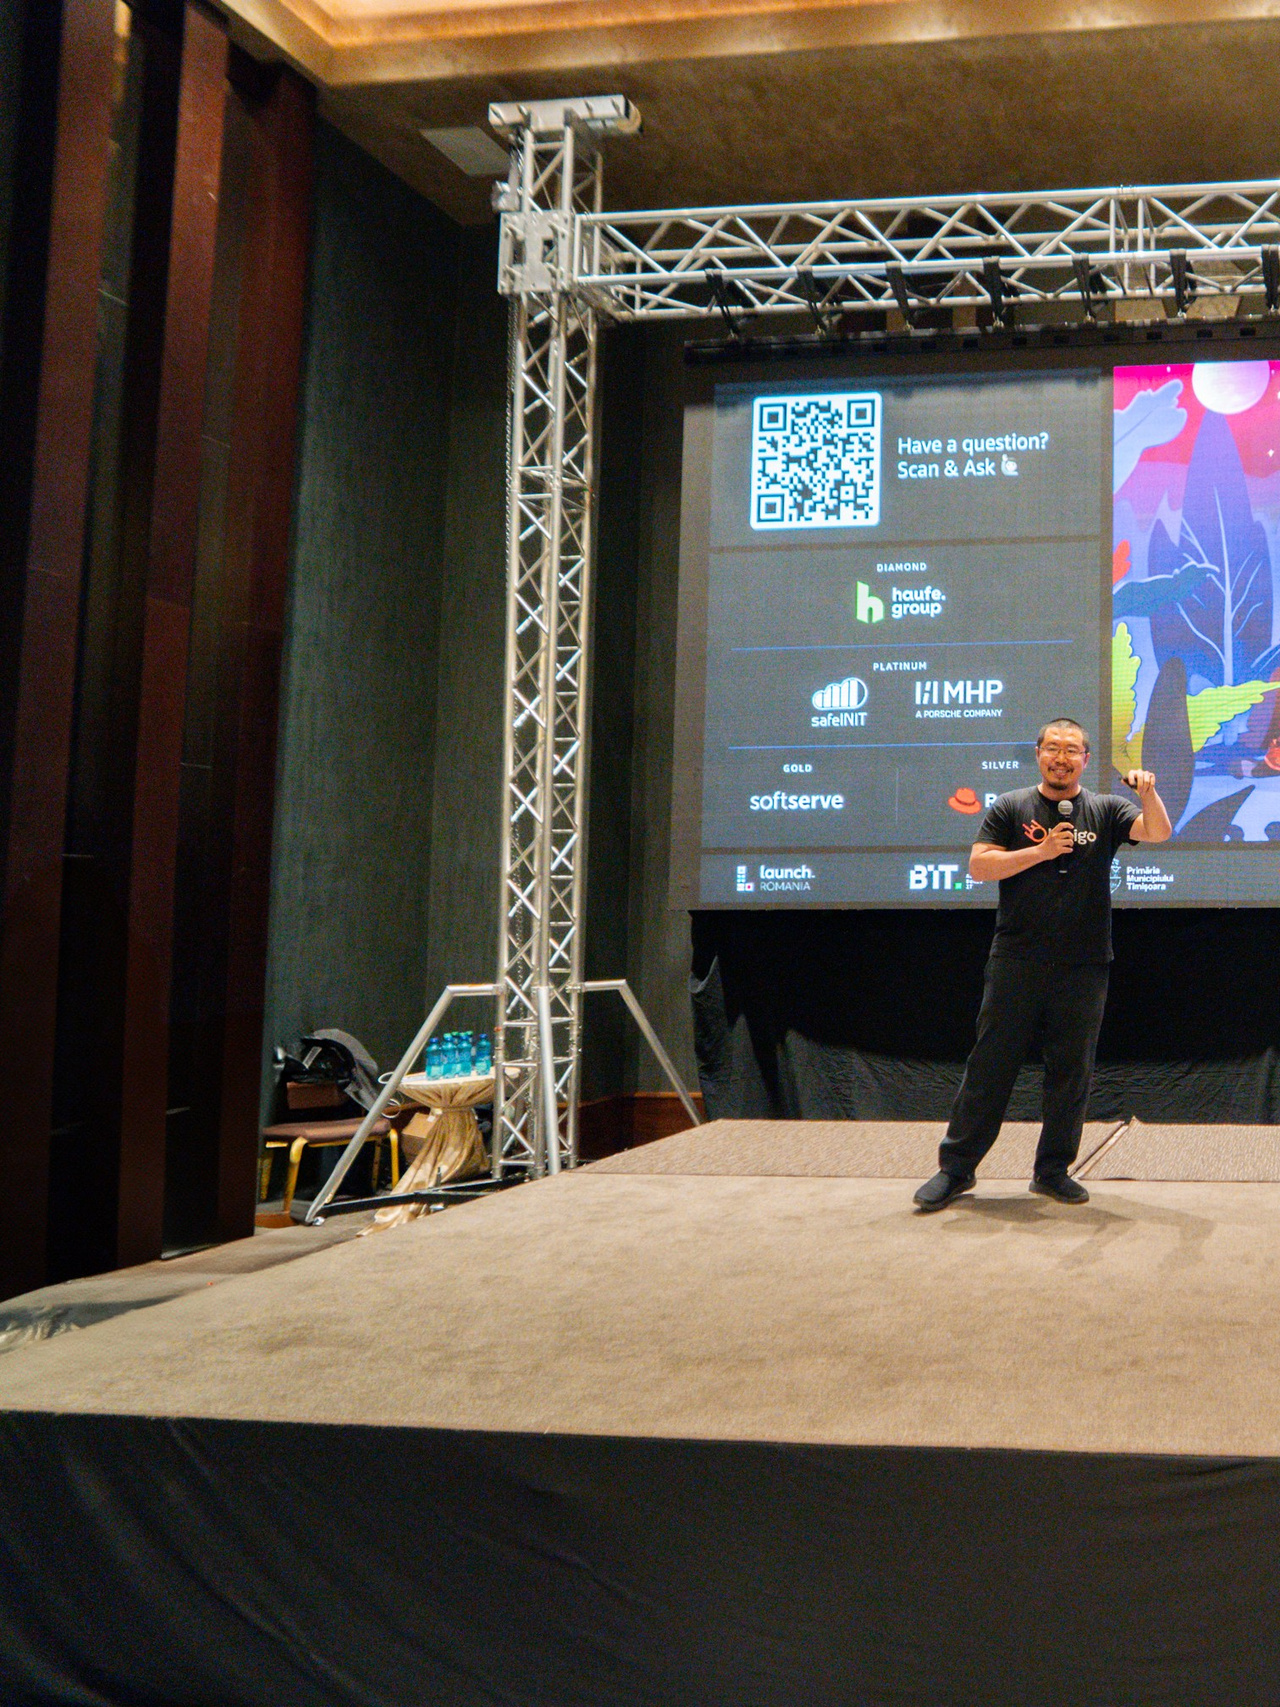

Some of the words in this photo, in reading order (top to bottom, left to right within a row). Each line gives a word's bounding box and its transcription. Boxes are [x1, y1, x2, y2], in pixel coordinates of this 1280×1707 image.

[898, 437, 942, 455] Have
[946, 438, 957, 453] a
[962, 431, 1049, 456] question?
[897, 461, 939, 479] Scan
[944, 459, 959, 477] &
[963, 457, 996, 477] Ask
[876, 562, 927, 572] DIAMOND
[892, 585, 946, 602] haufe.
[891, 602, 942, 619] group
[873, 661, 927, 672] PLATINUM
[943, 679, 1003, 704] MHP
[811, 711, 867, 727] safeINIT
[915, 710, 922, 718] A
[924, 709, 961, 718] PORSCHE
[963, 709, 1003, 718] COMPANY
[783, 764, 812, 773] GOLD
[982, 760, 1019, 770] SILVER
[750, 791, 844, 810] softserve
[760, 881, 811, 891] ROMANIA
